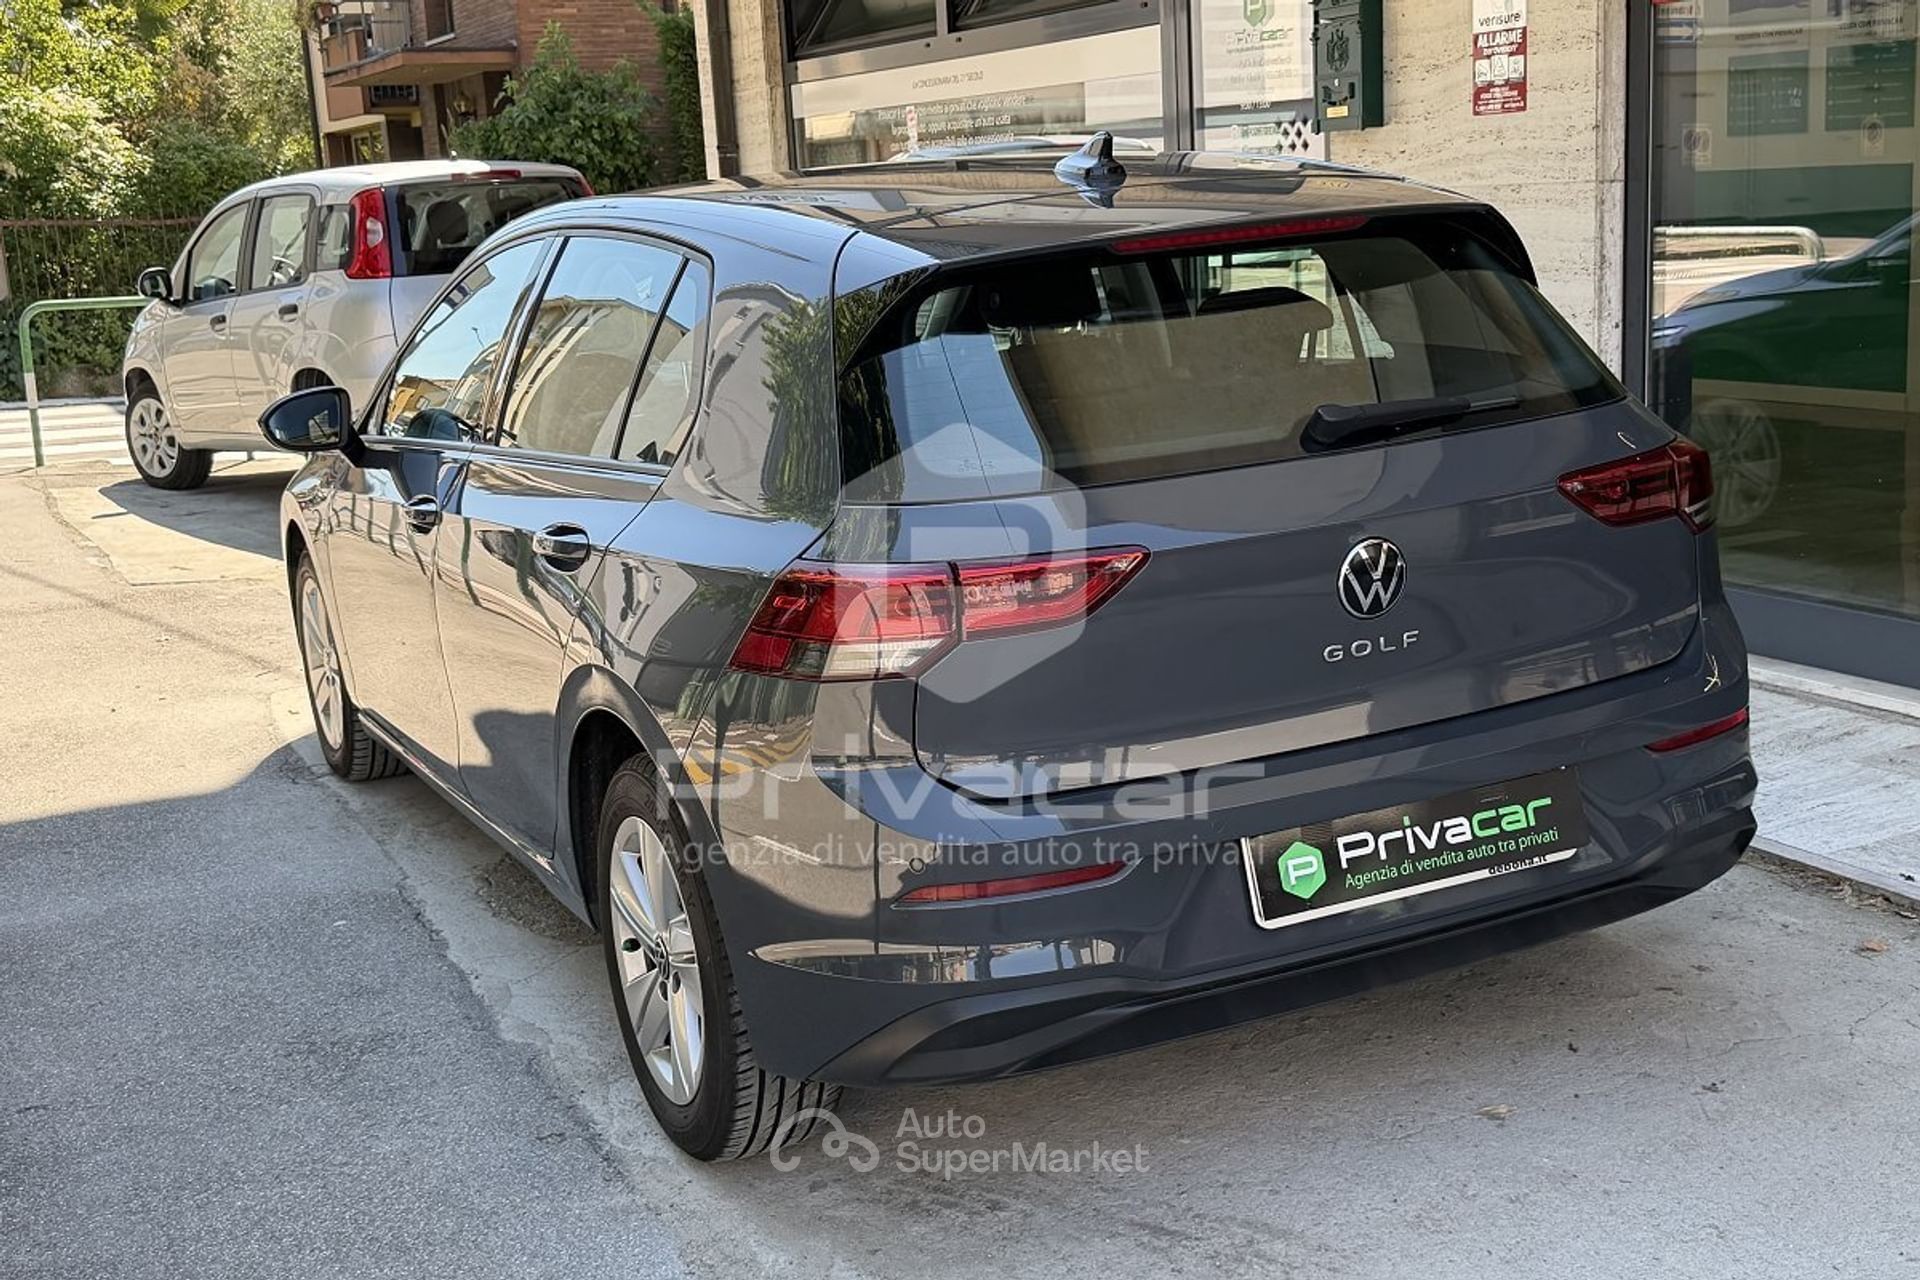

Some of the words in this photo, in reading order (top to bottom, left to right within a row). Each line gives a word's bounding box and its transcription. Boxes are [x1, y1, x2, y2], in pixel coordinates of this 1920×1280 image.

[1478, 12, 1521, 27] verisure
[1476, 29, 1523, 49] ALLARME
[1323, 630, 1419, 662] GOLF
[1336, 797, 1552, 870] Privacar
[1345, 865, 1398, 890] Agenzia
[1400, 859, 1414, 875] di
[1415, 851, 1464, 871] vendita
[1467, 844, 1496, 861] auto
[1498, 839, 1516, 853] tra
[1518, 826, 1559, 852] privati
